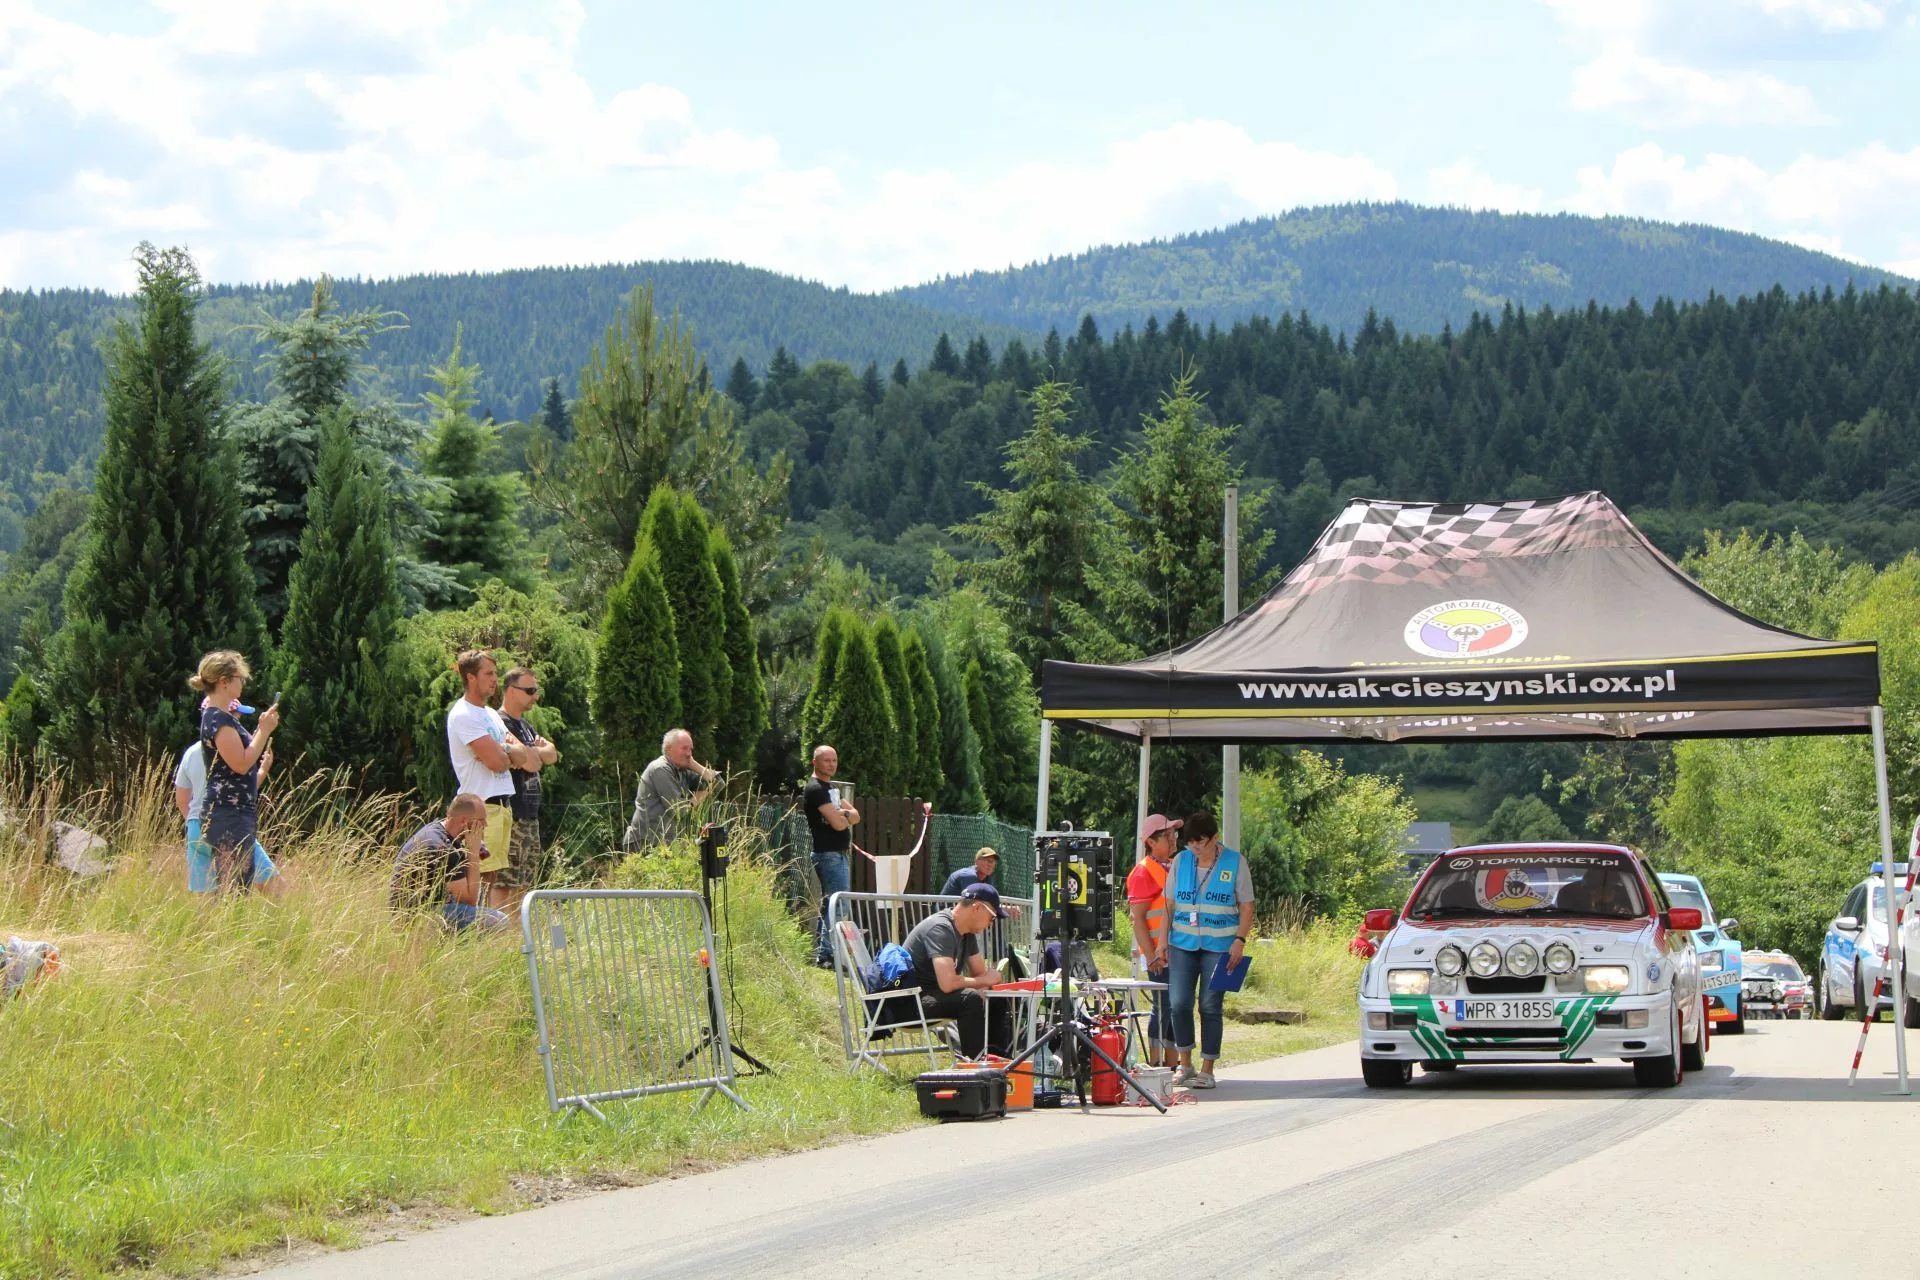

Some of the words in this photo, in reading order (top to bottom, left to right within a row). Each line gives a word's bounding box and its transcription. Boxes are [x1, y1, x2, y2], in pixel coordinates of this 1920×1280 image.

[1412, 600, 1523, 626] AUTOMOBILKLUB
[1238, 670, 1676, 701] www.ak-cieszynski.ox.pl
[1477, 857, 1619, 866] TOPMARKET.pl
[1205, 891, 1232, 904] CHIEF
[1465, 1002, 1496, 1018] WPR
[1502, 1002, 1552, 1018] 3185S
